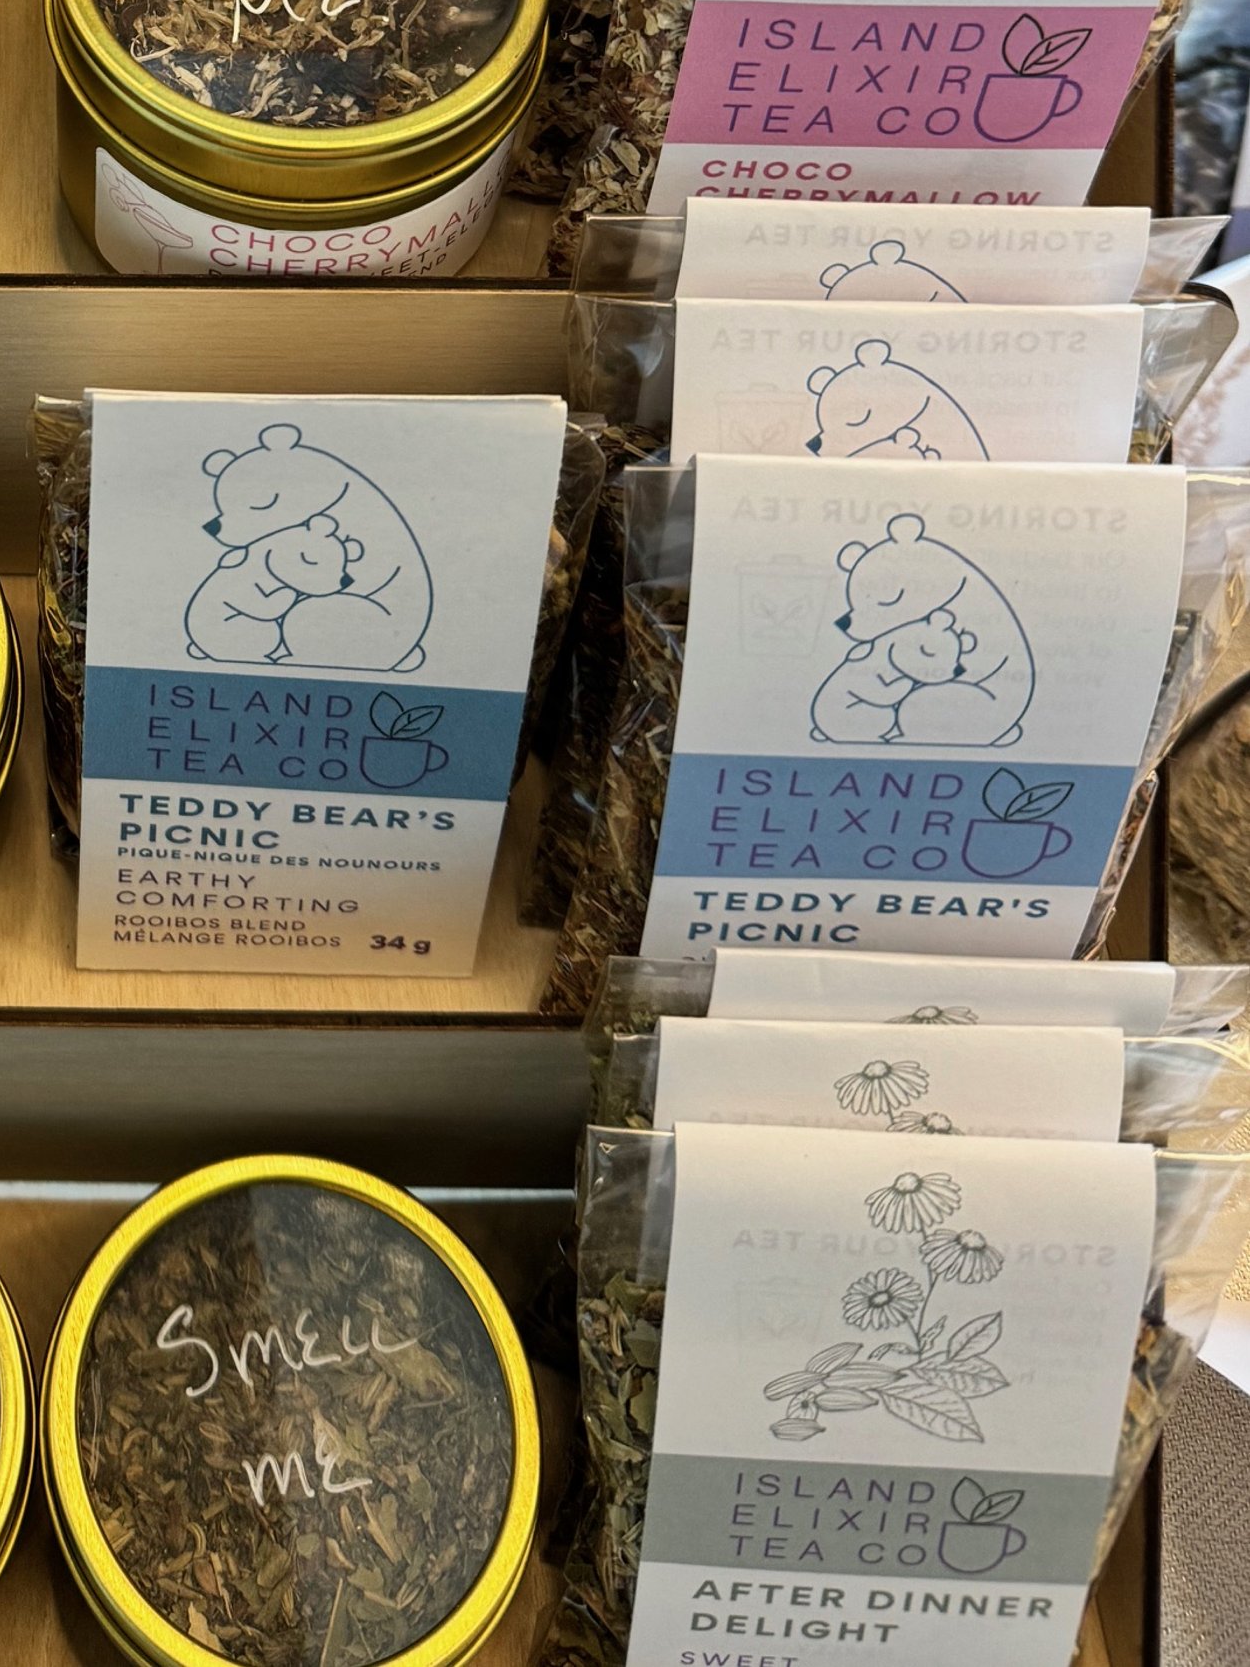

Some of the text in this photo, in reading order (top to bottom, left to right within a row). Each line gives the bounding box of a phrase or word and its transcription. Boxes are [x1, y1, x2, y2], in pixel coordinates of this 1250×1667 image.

[738, 18, 987, 53] ISLAND
[728, 62, 972, 95] ELIXIR
[722, 104, 961, 138] TEA CO
[702, 159, 853, 181] CHOCO
[211, 224, 393, 254] CHOCO
[151, 685, 353, 718] ISLAND
[150, 717, 350, 750] ELIXIR
[148, 748, 348, 782] TEA CO
[716, 769, 964, 801] ISLAND
[119, 793, 272, 822] TEDDY
[710, 806, 953, 836] ELIXIR
[119, 822, 281, 850] PICNIC
[117, 846, 441, 873] PIQUE-NIQUE DES NOUNOURS
[707, 842, 947, 872] TEA CO
[118, 869, 256, 890] EARTHY
[116, 891, 360, 914] COMFORTING
[693, 891, 856, 913] TEDDY
[115, 915, 306, 932] ROOIBOS BLEND
[687, 922, 860, 943] PICNIC
[236, 934, 341, 948] ROOIBOS
[370, 934, 410, 952] 34
[735, 1472, 935, 1504] ISLAND
[732, 1504, 930, 1534] ELIXIR
[730, 1535, 926, 1565] TEA CO
[692, 1580, 1053, 1618] AFTER DINNER
[690, 1613, 899, 1643] DELIGHT
[680, 1651, 799, 1667] SWEET
